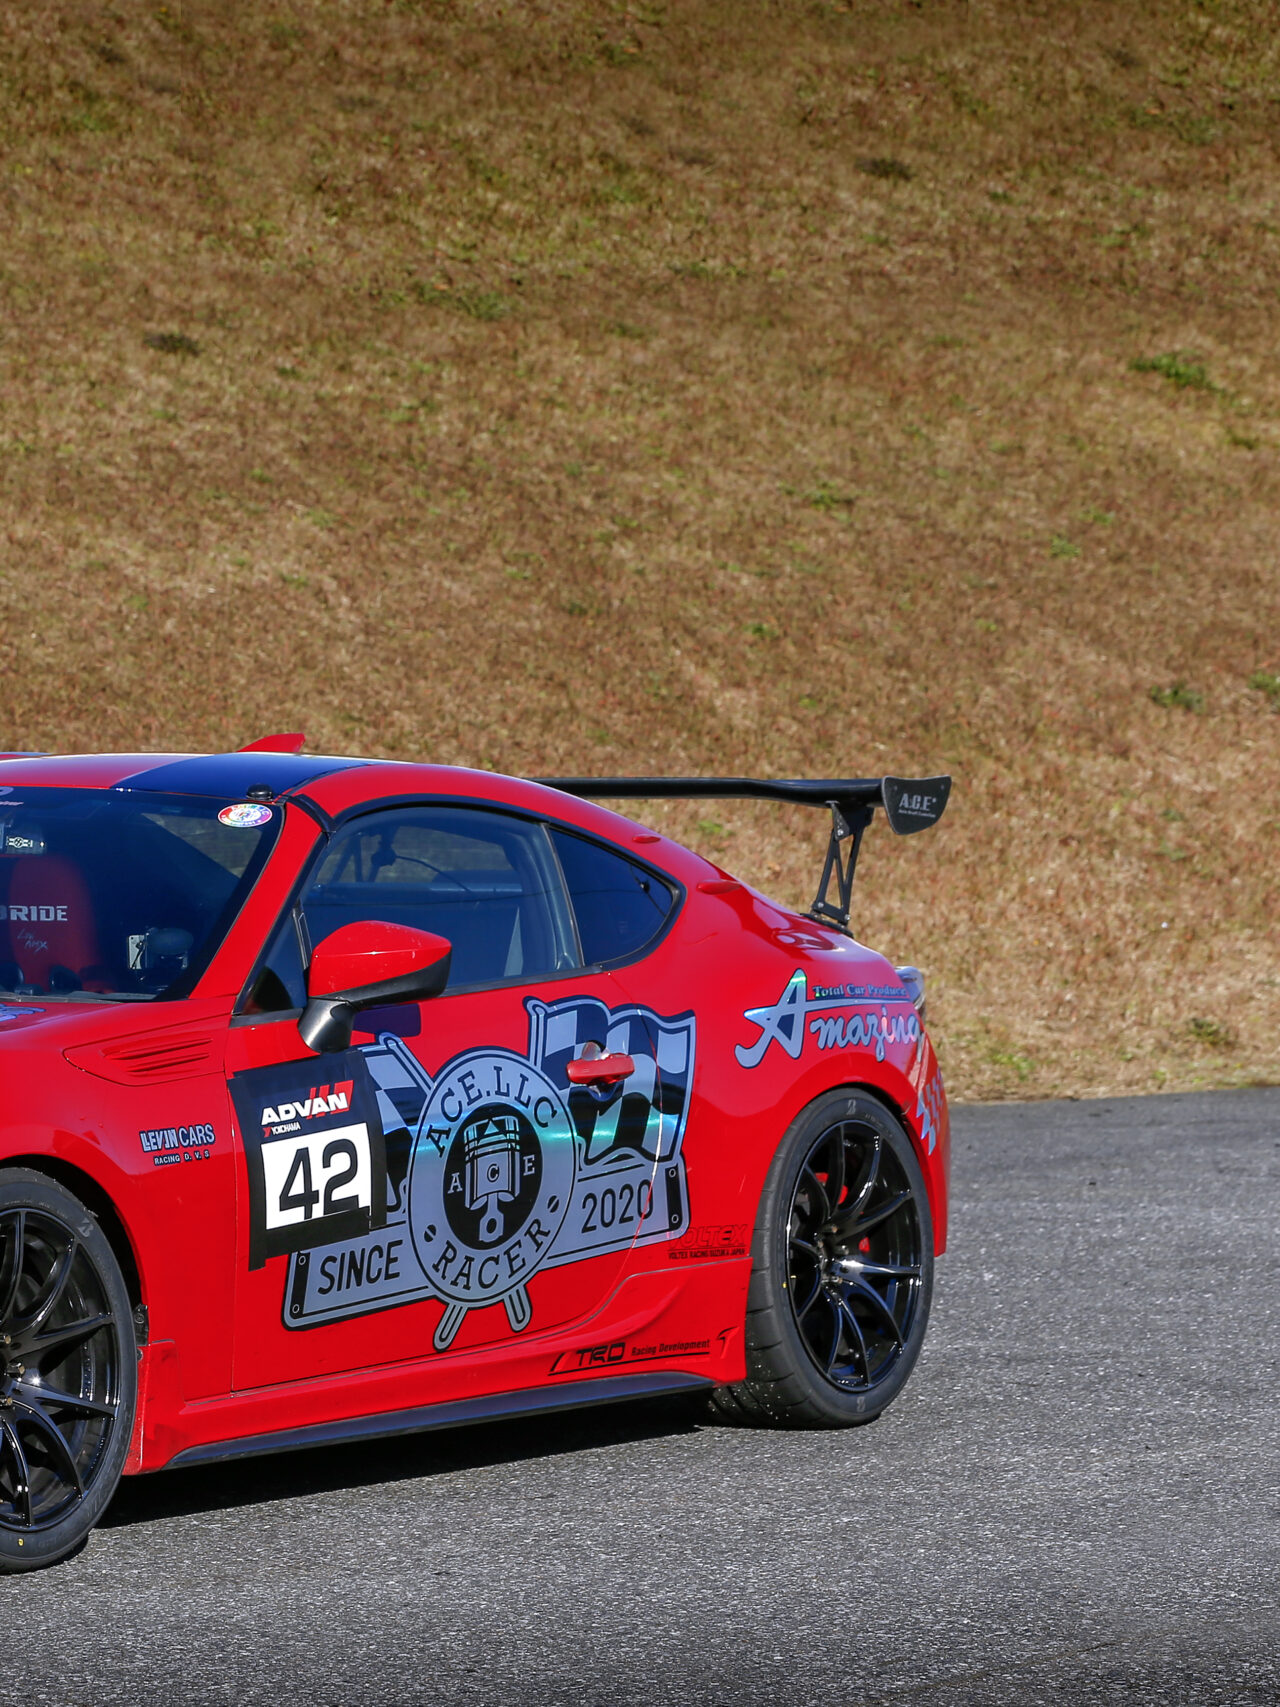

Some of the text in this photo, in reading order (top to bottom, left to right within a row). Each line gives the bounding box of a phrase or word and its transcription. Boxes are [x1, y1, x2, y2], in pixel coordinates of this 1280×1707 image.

[812, 984, 844, 998] Total
[846, 984, 866, 997] Car
[261, 1091, 349, 1127] ADVAN
[426, 1065, 558, 1158] ACE.LLC
[139, 1123, 215, 1152] LEVIN CARS
[154, 1154, 180, 1165] RACING
[279, 1138, 361, 1221] 42
[581, 1178, 654, 1234] 2020
[317, 1239, 404, 1295] SINCE
[431, 1218, 550, 1291] RACER
[576, 1339, 710, 1367] TRD Racing Development
